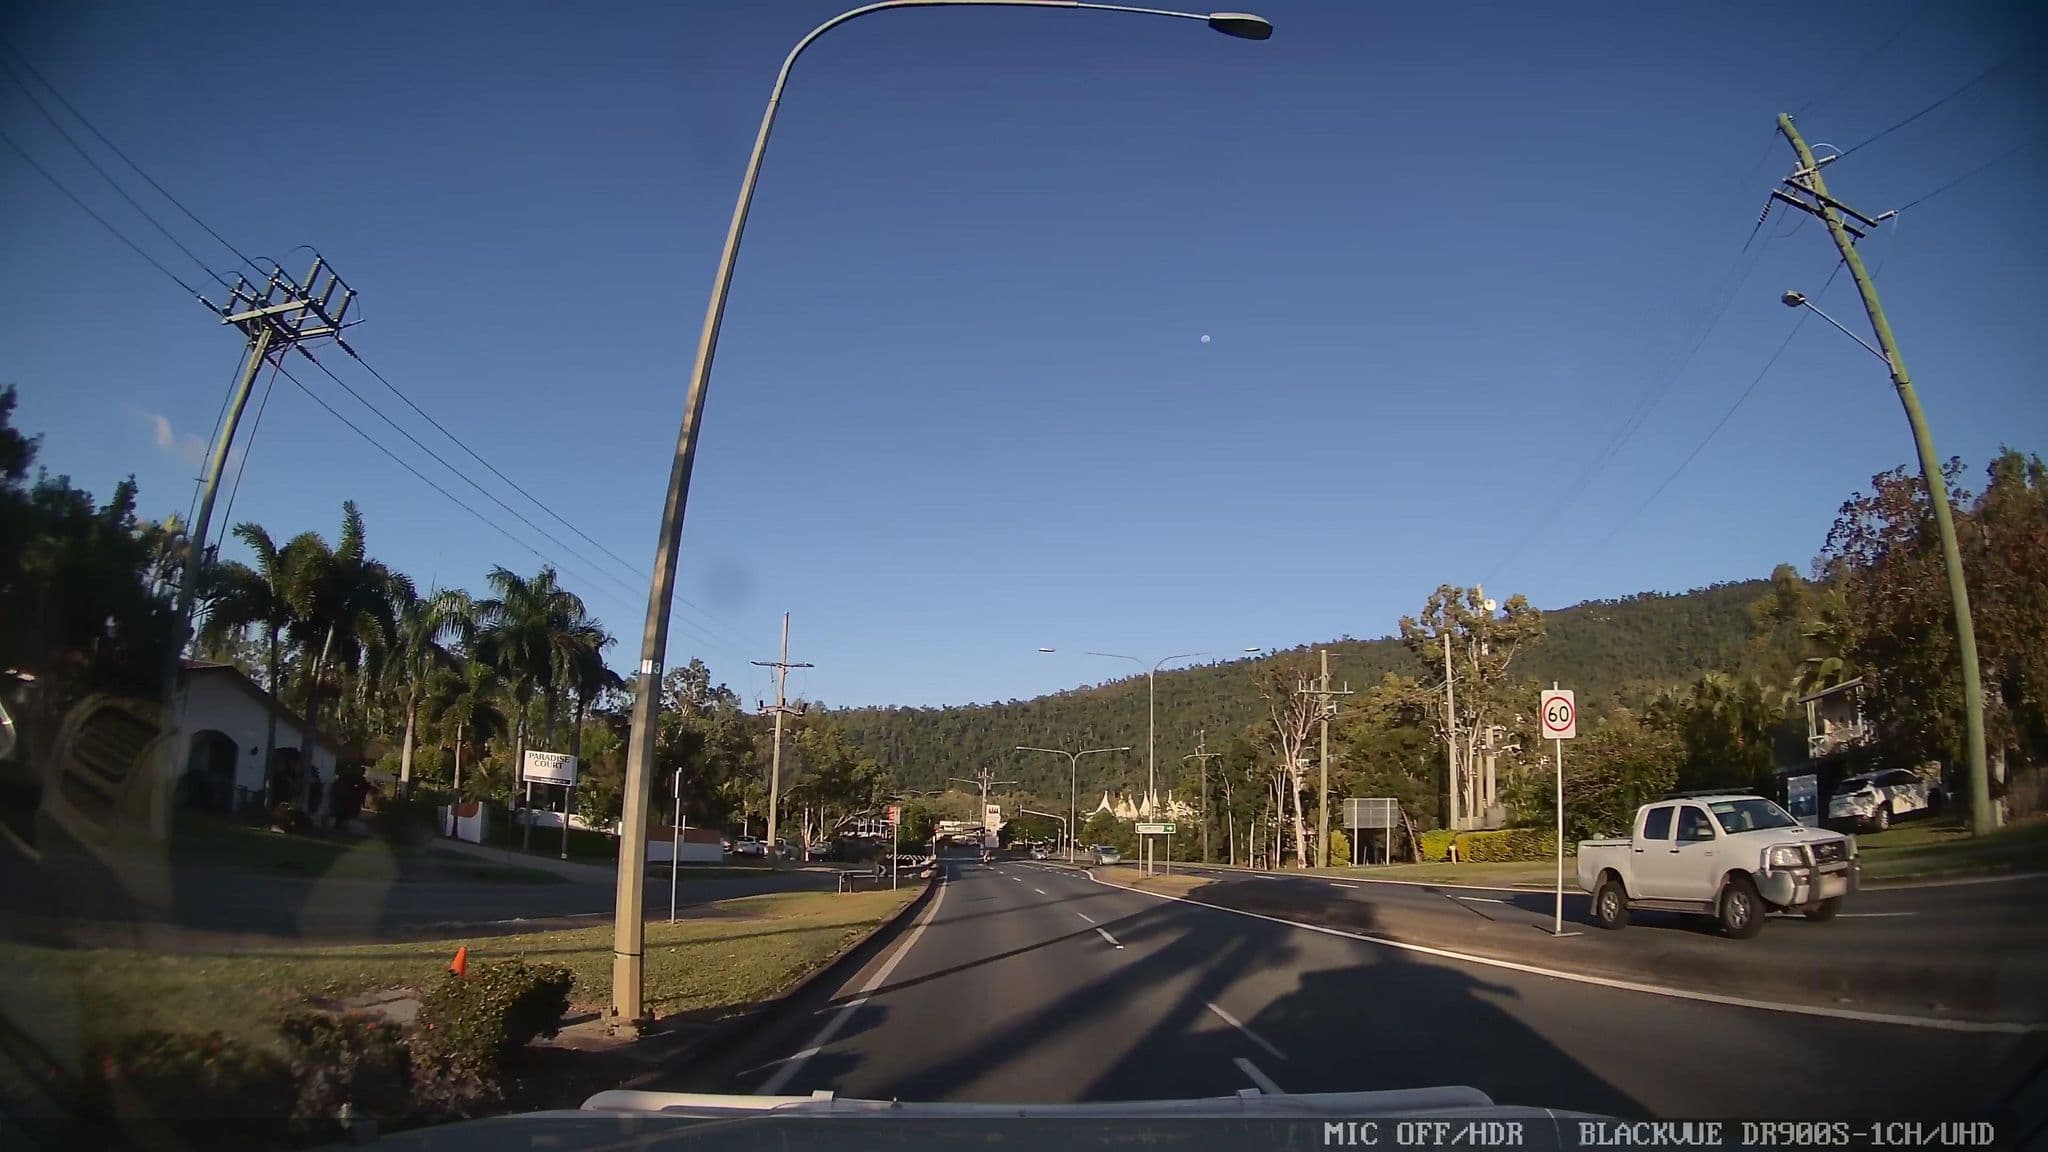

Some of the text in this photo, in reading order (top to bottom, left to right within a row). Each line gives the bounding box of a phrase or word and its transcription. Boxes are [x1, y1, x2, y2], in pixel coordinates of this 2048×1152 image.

[1548, 705, 1569, 722] 60
[528, 752, 570, 764] PARADISE
[534, 760, 564, 769] COURT
